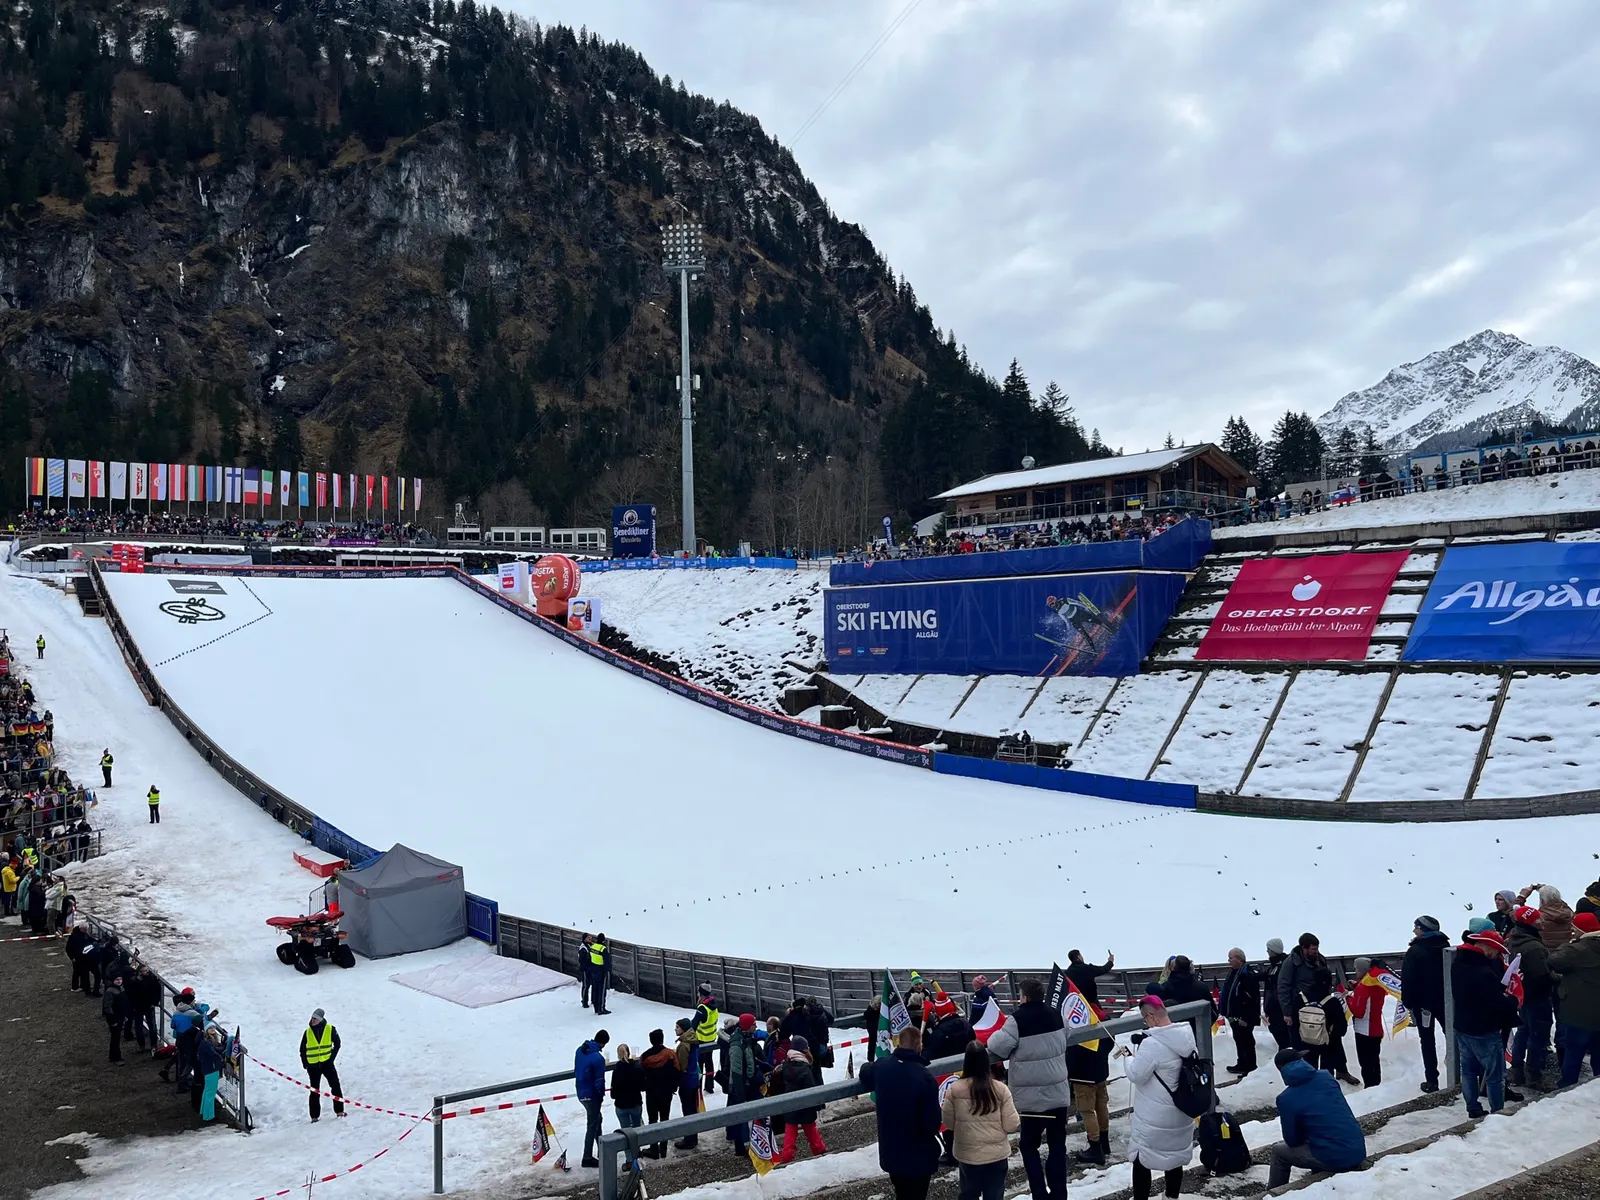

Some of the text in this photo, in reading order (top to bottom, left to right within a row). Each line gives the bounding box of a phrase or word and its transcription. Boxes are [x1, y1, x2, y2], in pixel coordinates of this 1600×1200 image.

[1228, 606, 1372, 618] OBERSTDORF
[837, 609, 937, 632] SKI FLYING
[916, 630, 938, 638] ALLGÄU
[1221, 621, 1363, 634] Das Hochgefühl der Alpen.
[876, 745, 905, 760] Benediktiner
